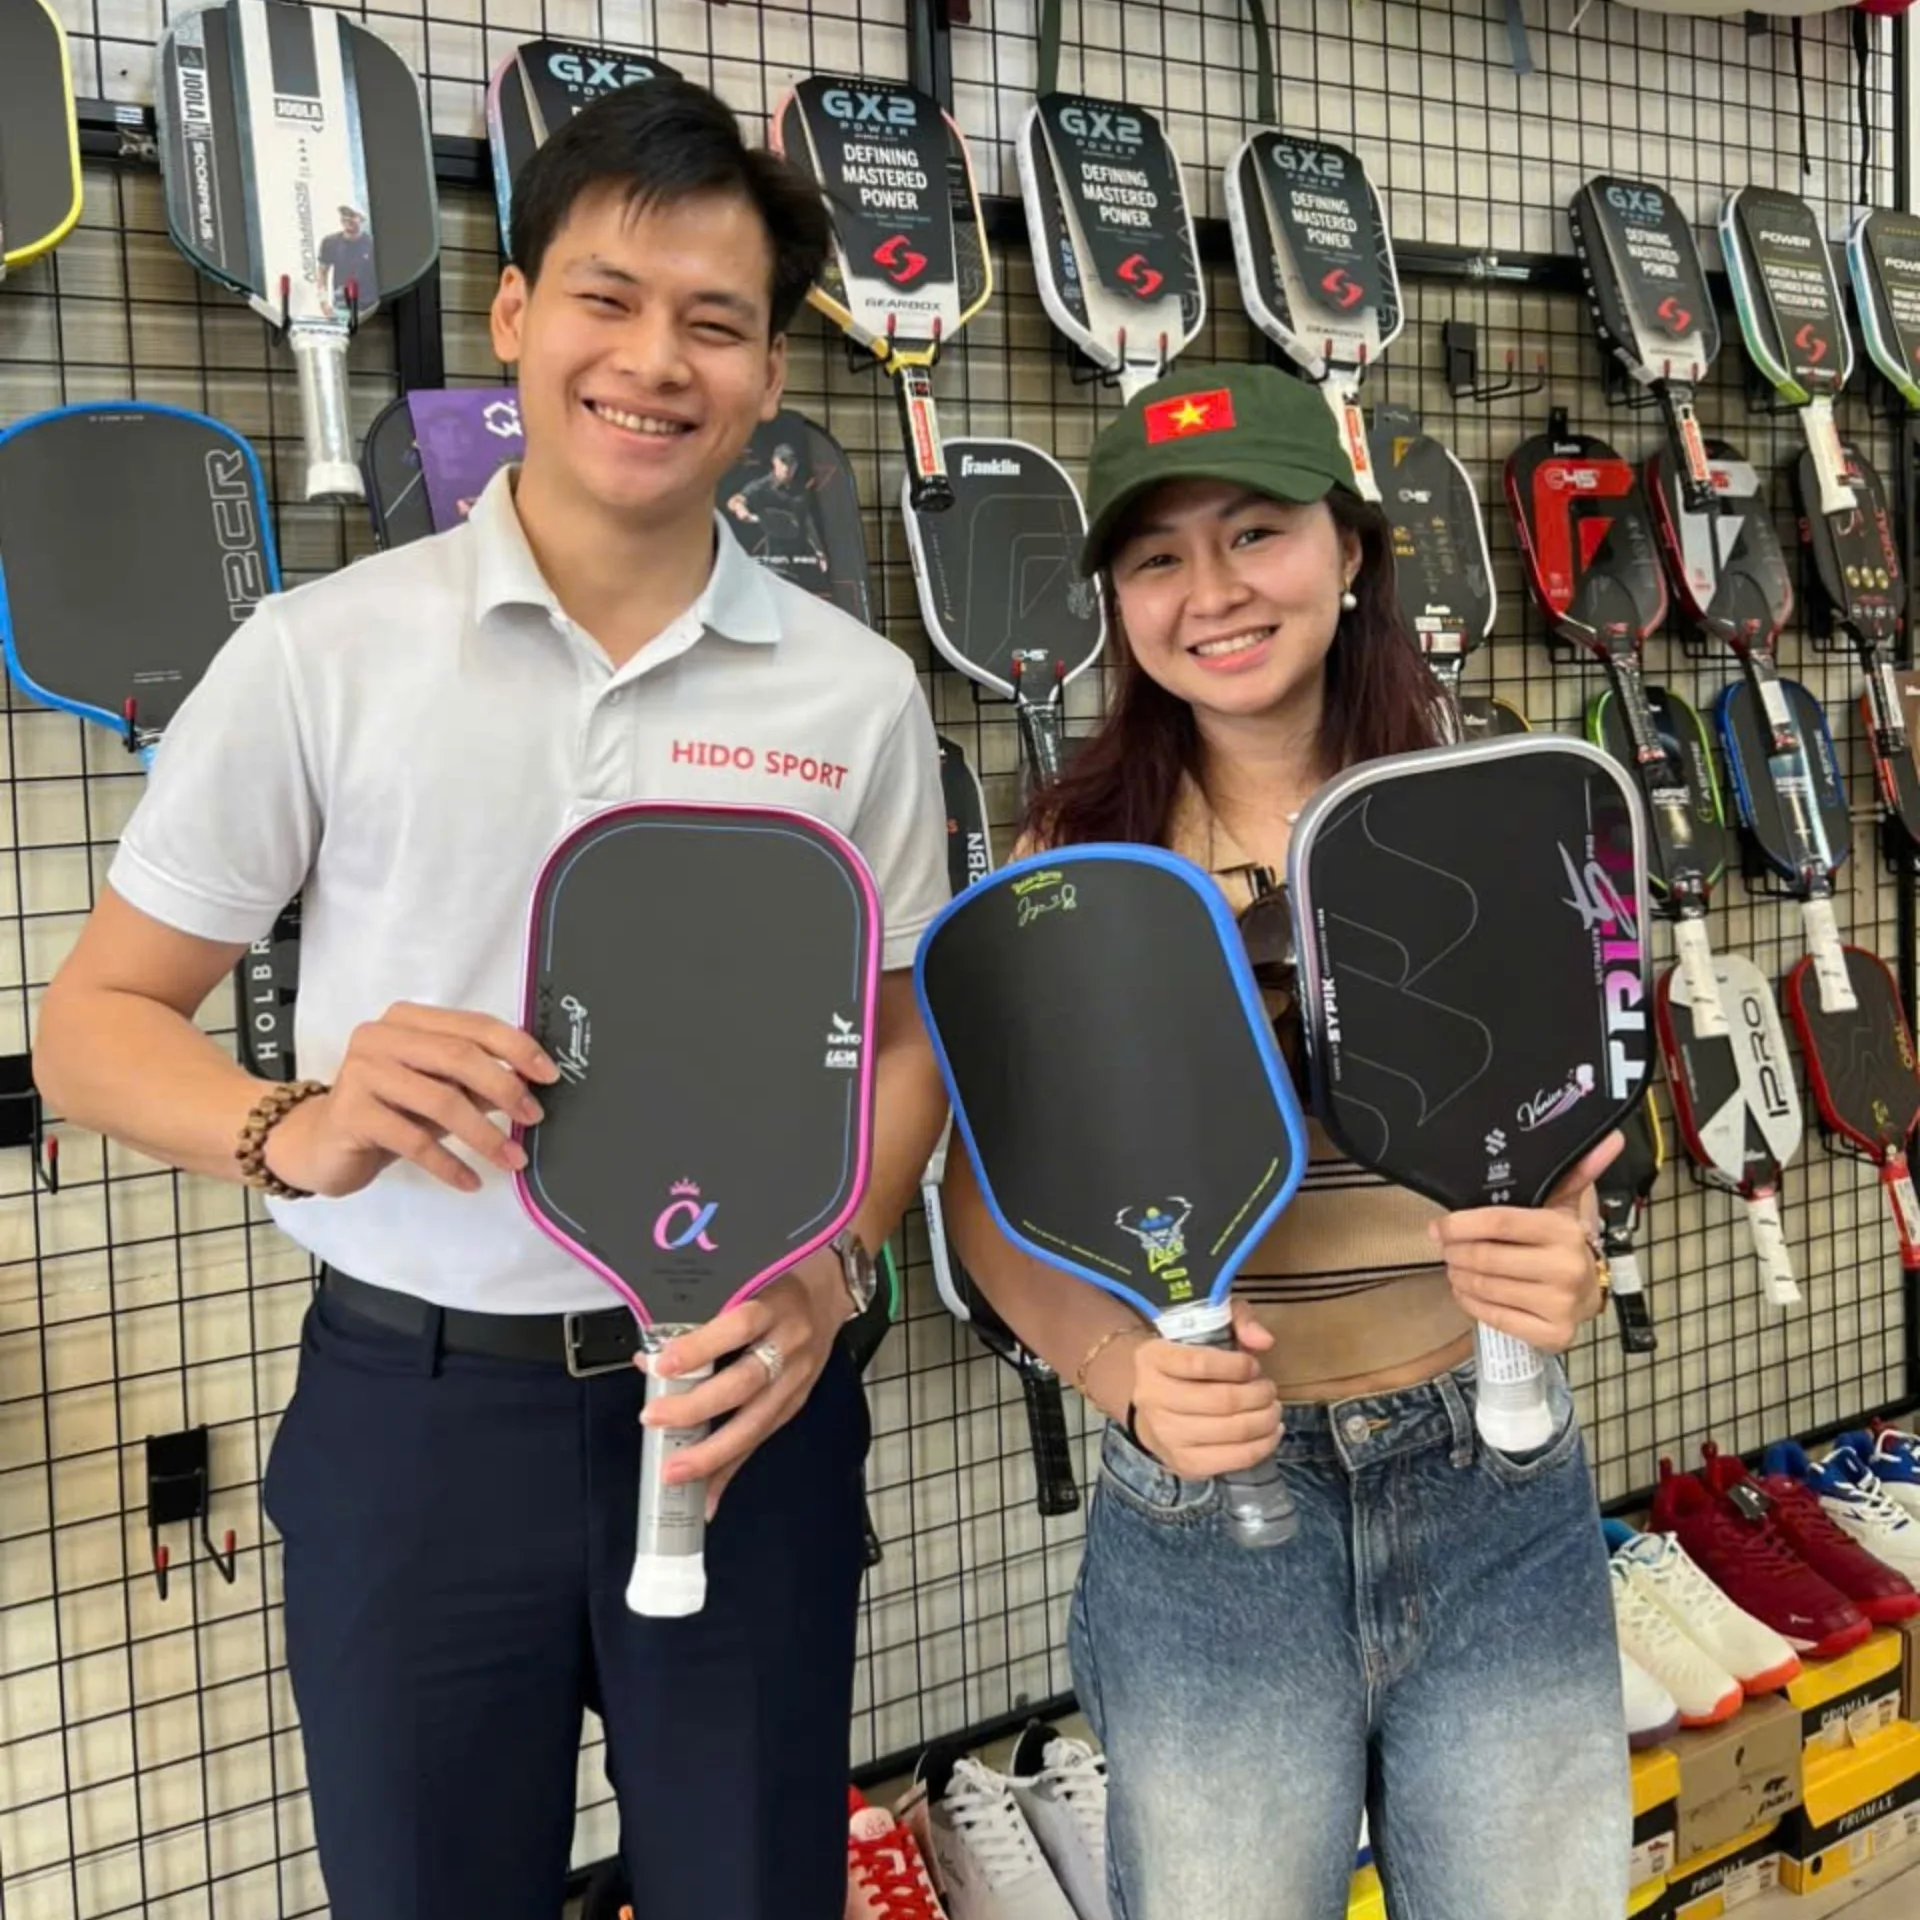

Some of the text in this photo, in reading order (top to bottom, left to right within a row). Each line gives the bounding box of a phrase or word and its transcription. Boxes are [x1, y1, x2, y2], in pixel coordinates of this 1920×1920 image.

[183, 72, 206, 119] JOOLA
[822, 89, 917, 126] GX2
[839, 121, 909, 137] POWER
[1059, 107, 1144, 145] GX2
[843, 143, 919, 168] DEFINING
[1271, 144, 1345, 180] GX2
[841, 164, 928, 190] MASTERED
[1080, 162, 1149, 188] DEFINING
[860, 188, 919, 211] POWER
[1081, 182, 1159, 209] MASTERED
[1290, 190, 1350, 215] DEFINING
[1605, 186, 1665, 217] GX2
[1291, 207, 1358, 234] MASTERED
[1759, 230, 1811, 249] POWER
[865, 297, 942, 311] GEARBOX
[961, 453, 1021, 477] Franklin
[671, 740, 849, 790] HIDO SPORT
[1321, 976, 1342, 1043] SYPIK
[1837, 1792, 1896, 1834] PROMAX
